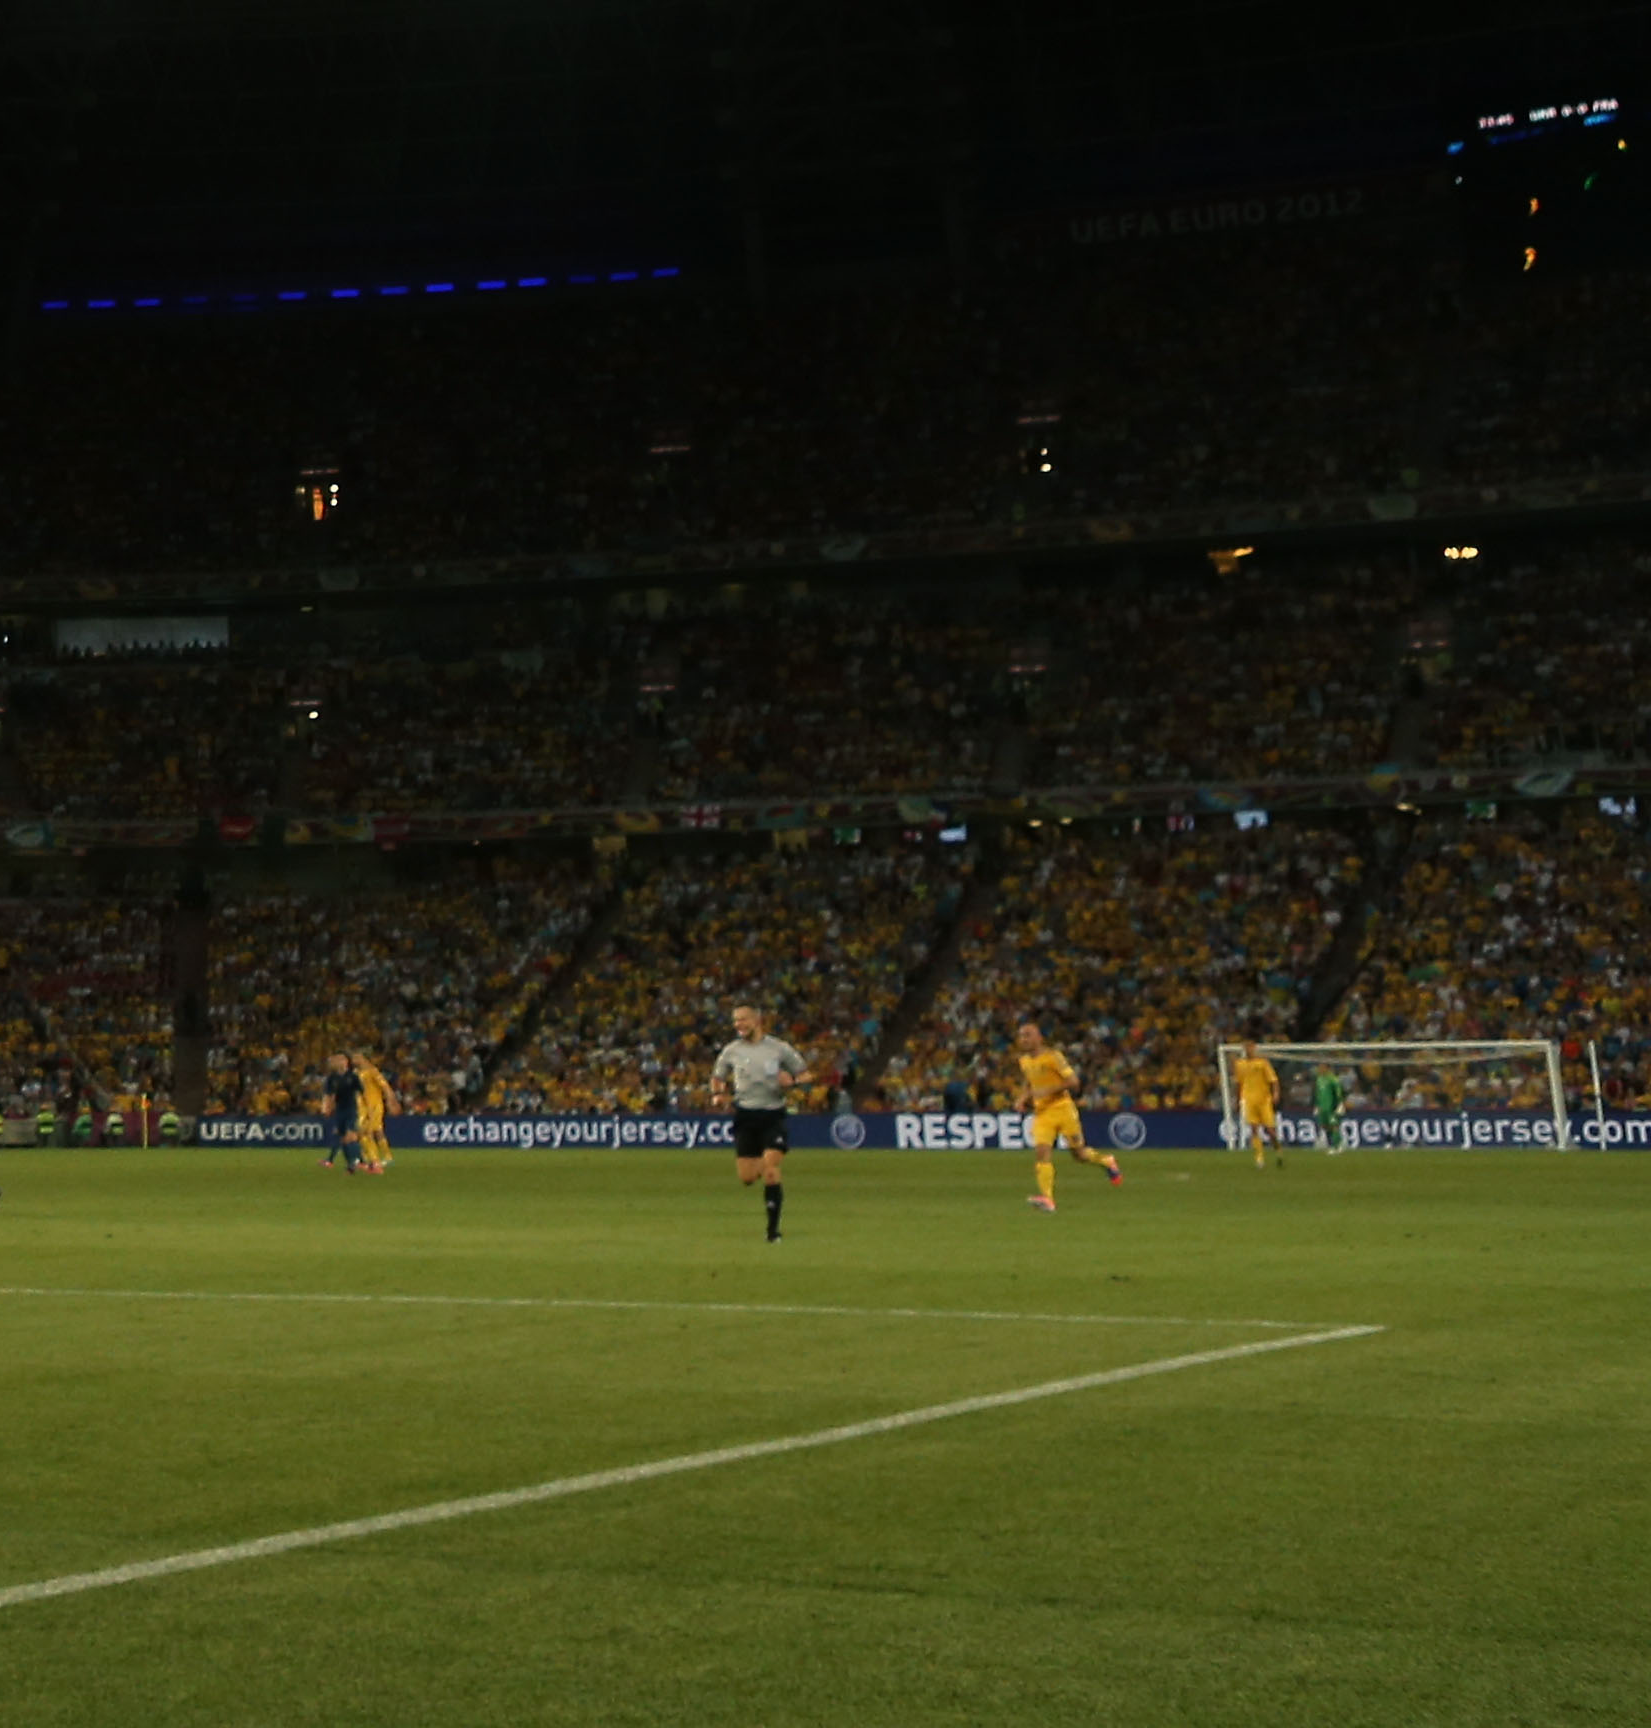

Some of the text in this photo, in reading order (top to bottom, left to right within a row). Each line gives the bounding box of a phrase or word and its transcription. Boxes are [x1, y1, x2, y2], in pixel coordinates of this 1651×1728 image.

[1069, 186, 1363, 244] UEFA EURO 2012
